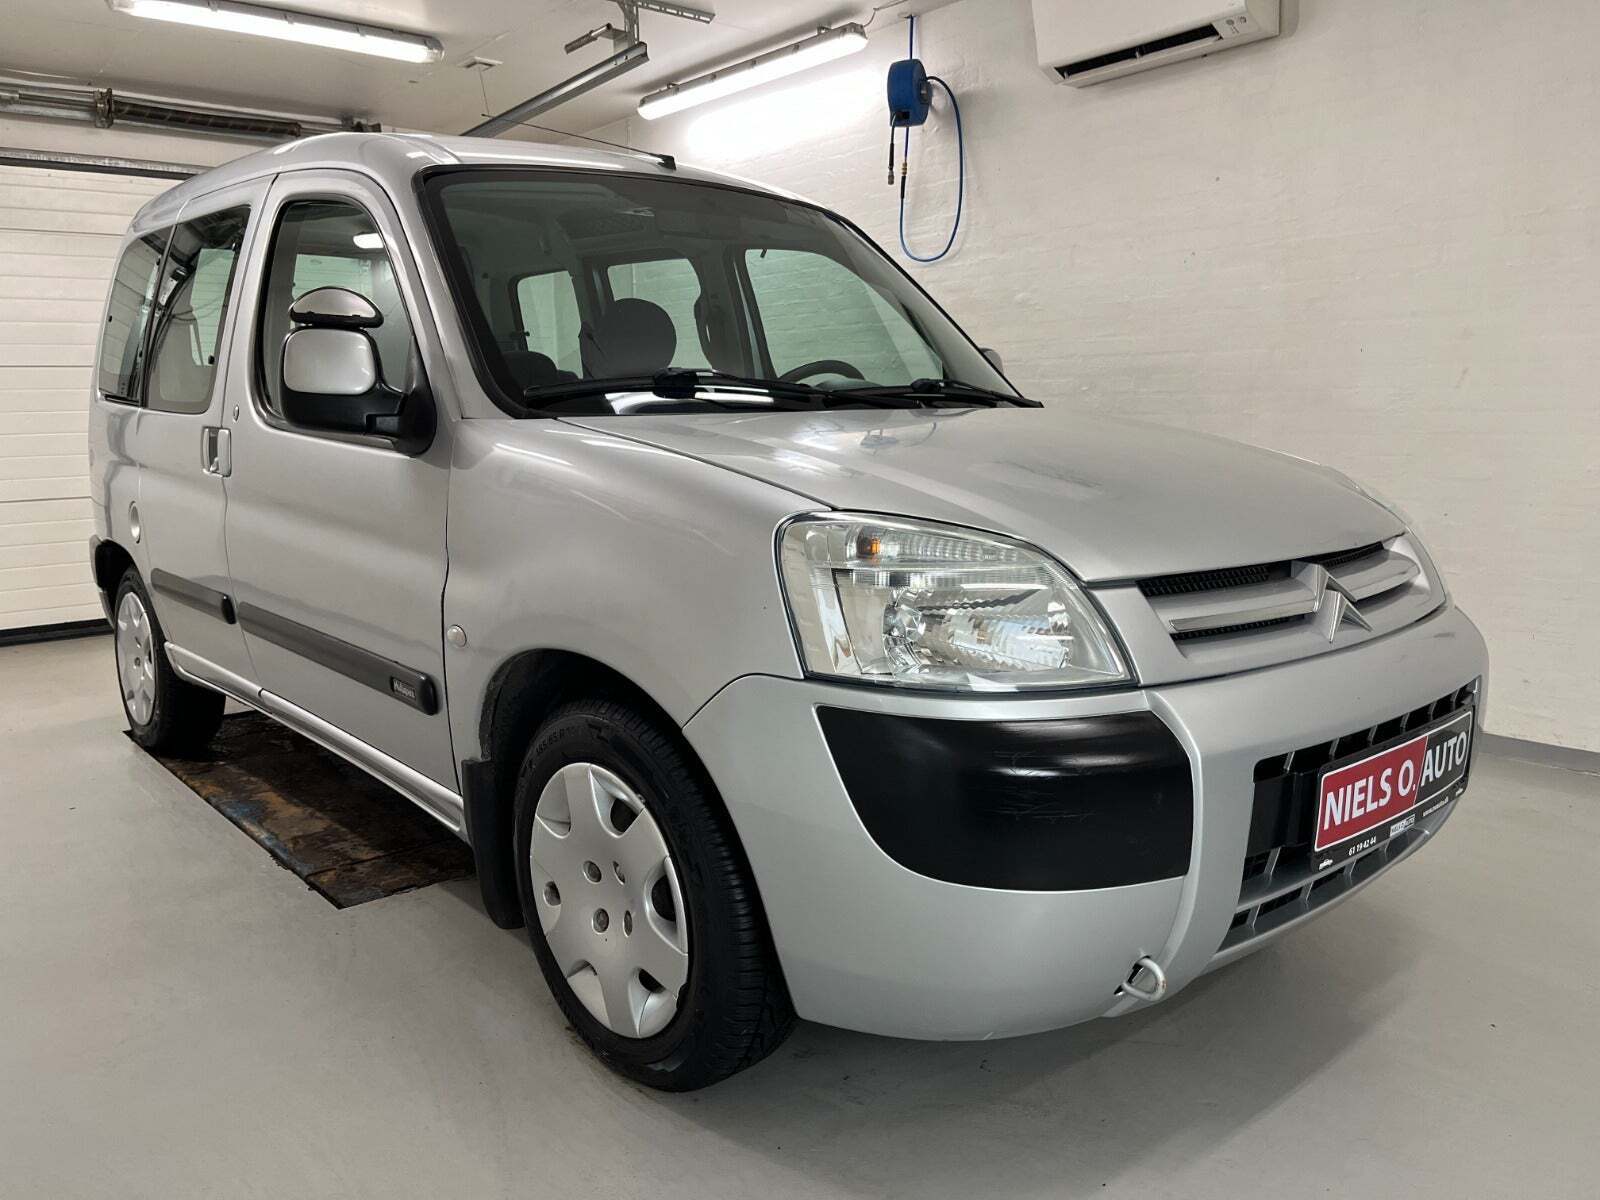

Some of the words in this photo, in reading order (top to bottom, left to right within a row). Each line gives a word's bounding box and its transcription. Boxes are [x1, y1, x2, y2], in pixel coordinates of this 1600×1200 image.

[1322, 767, 1392, 831] NIELS
[1397, 758, 1416, 798] O.
[1420, 731, 1467, 787] AUTO
[1363, 839, 1370, 849] 42
[1370, 835, 1377, 845] 44
